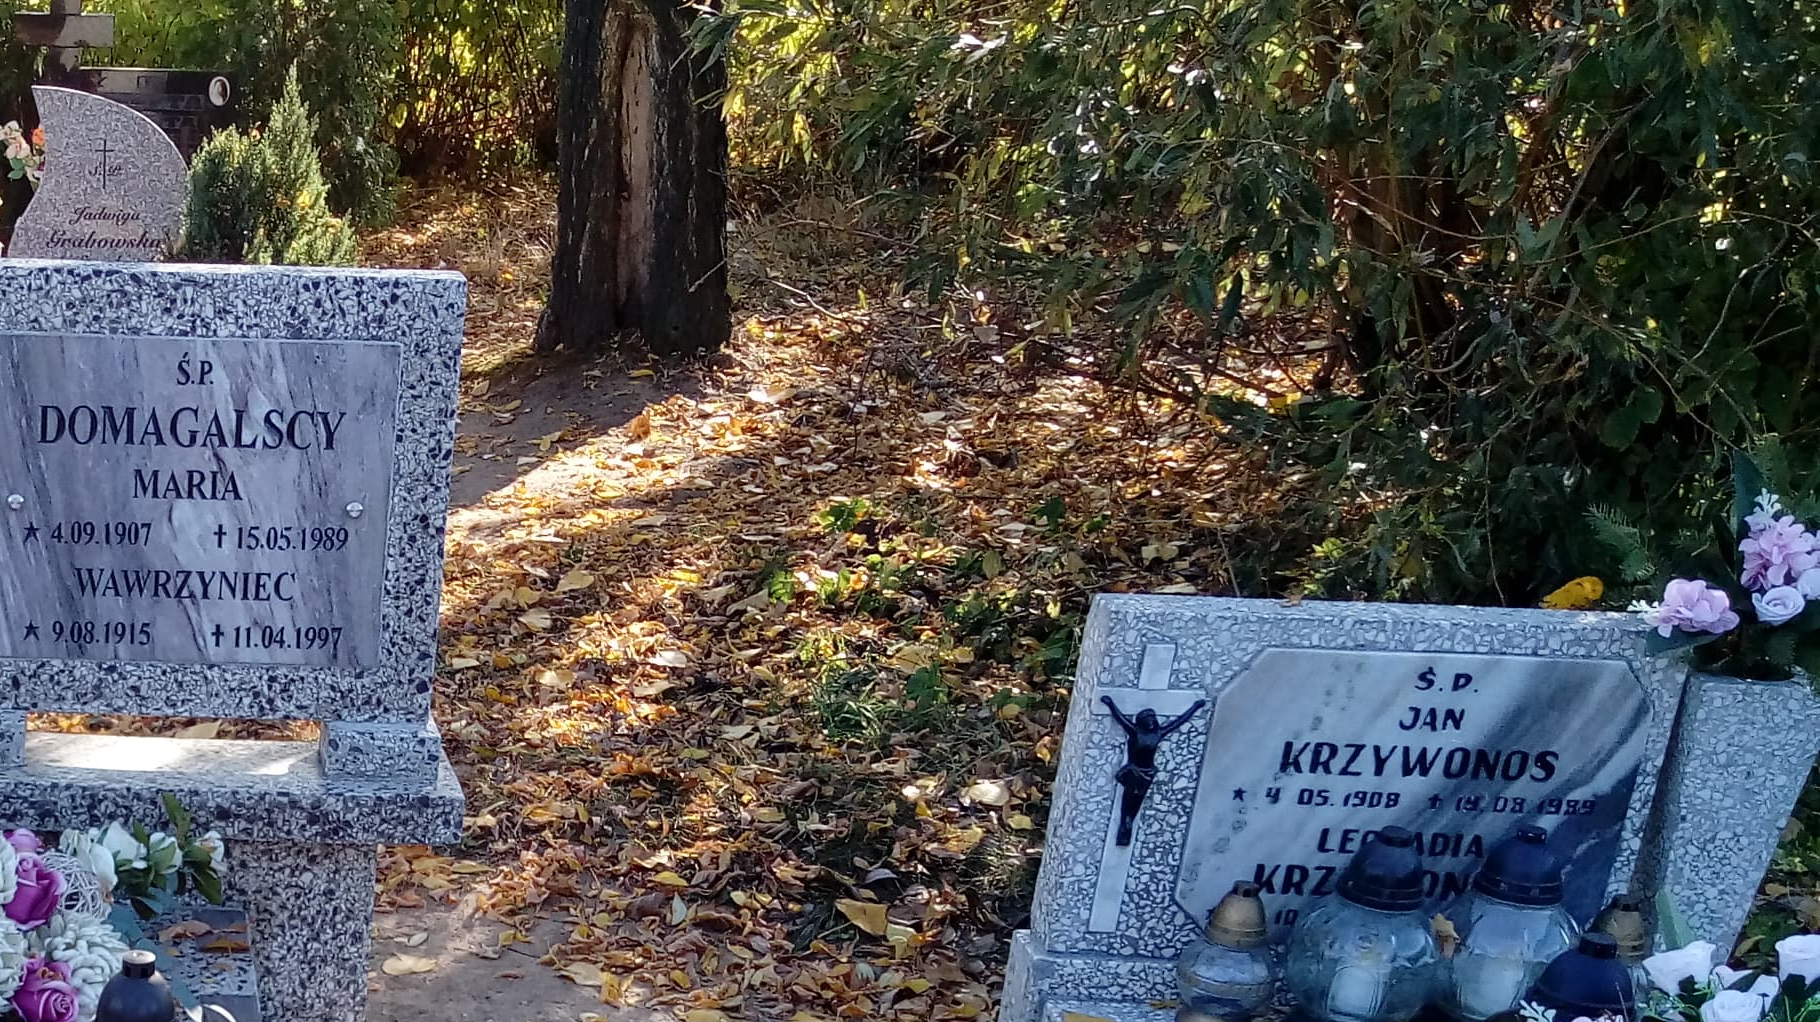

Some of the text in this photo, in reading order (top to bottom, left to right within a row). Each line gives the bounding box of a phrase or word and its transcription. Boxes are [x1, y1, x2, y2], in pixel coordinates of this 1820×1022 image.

[46, 229, 162, 249] Grabowska
[176, 352, 214, 385] Ś.P.
[37, 405, 347, 451] DOMAGALSCY
[132, 468, 244, 501] MARIA
[51, 521, 349, 551] 4.09.1907 15.05.1989
[74, 567, 297, 601] WAWRZYNIEC
[52, 621, 343, 650] 9.08.1915 11.04.1997
[1399, 706, 1465, 732] JAN
[1279, 741, 1560, 783] KRZYWONOS
[1317, 827, 1484, 859] LEOADIA
